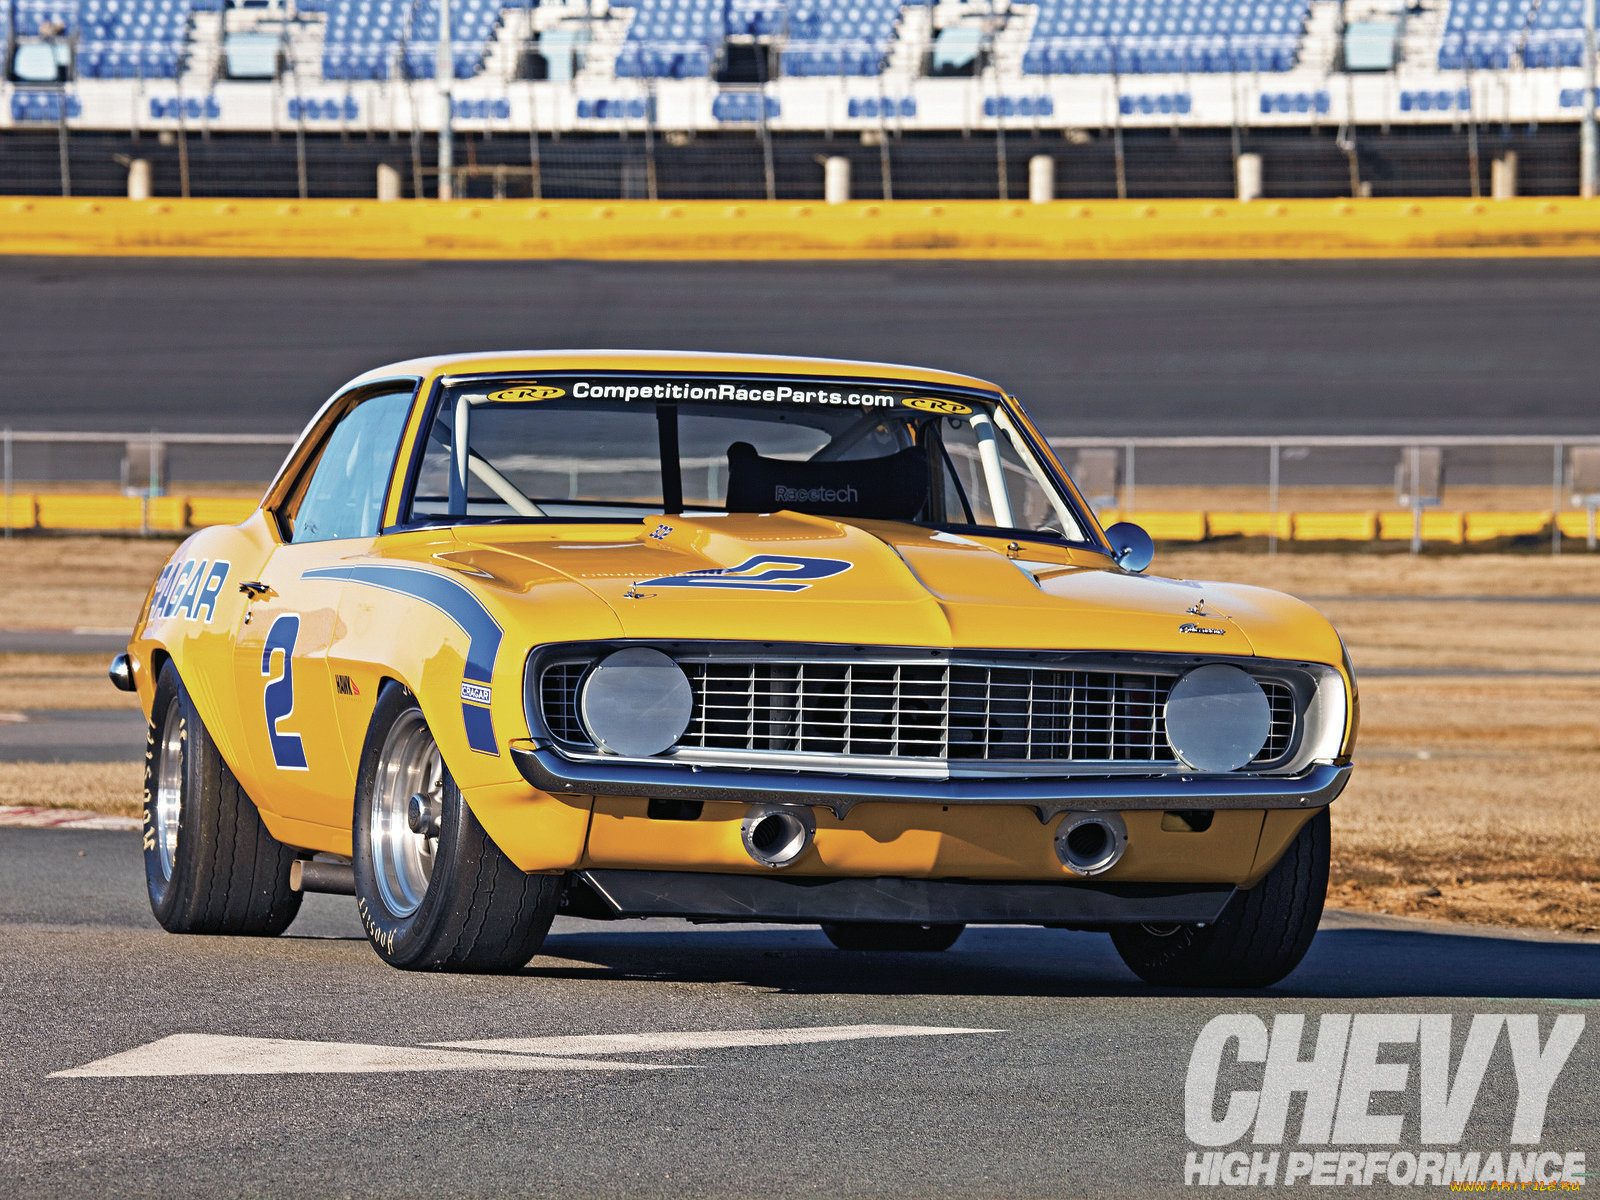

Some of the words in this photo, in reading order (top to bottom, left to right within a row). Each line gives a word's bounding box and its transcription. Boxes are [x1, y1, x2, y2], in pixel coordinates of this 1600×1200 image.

[572, 381, 895, 408] CompetitionRaceParts.com
[150, 559, 230, 624] RAGAR
[628, 554, 854, 592] 2
[261, 612, 309, 771] 2
[462, 685, 490, 701] CRAGAR
